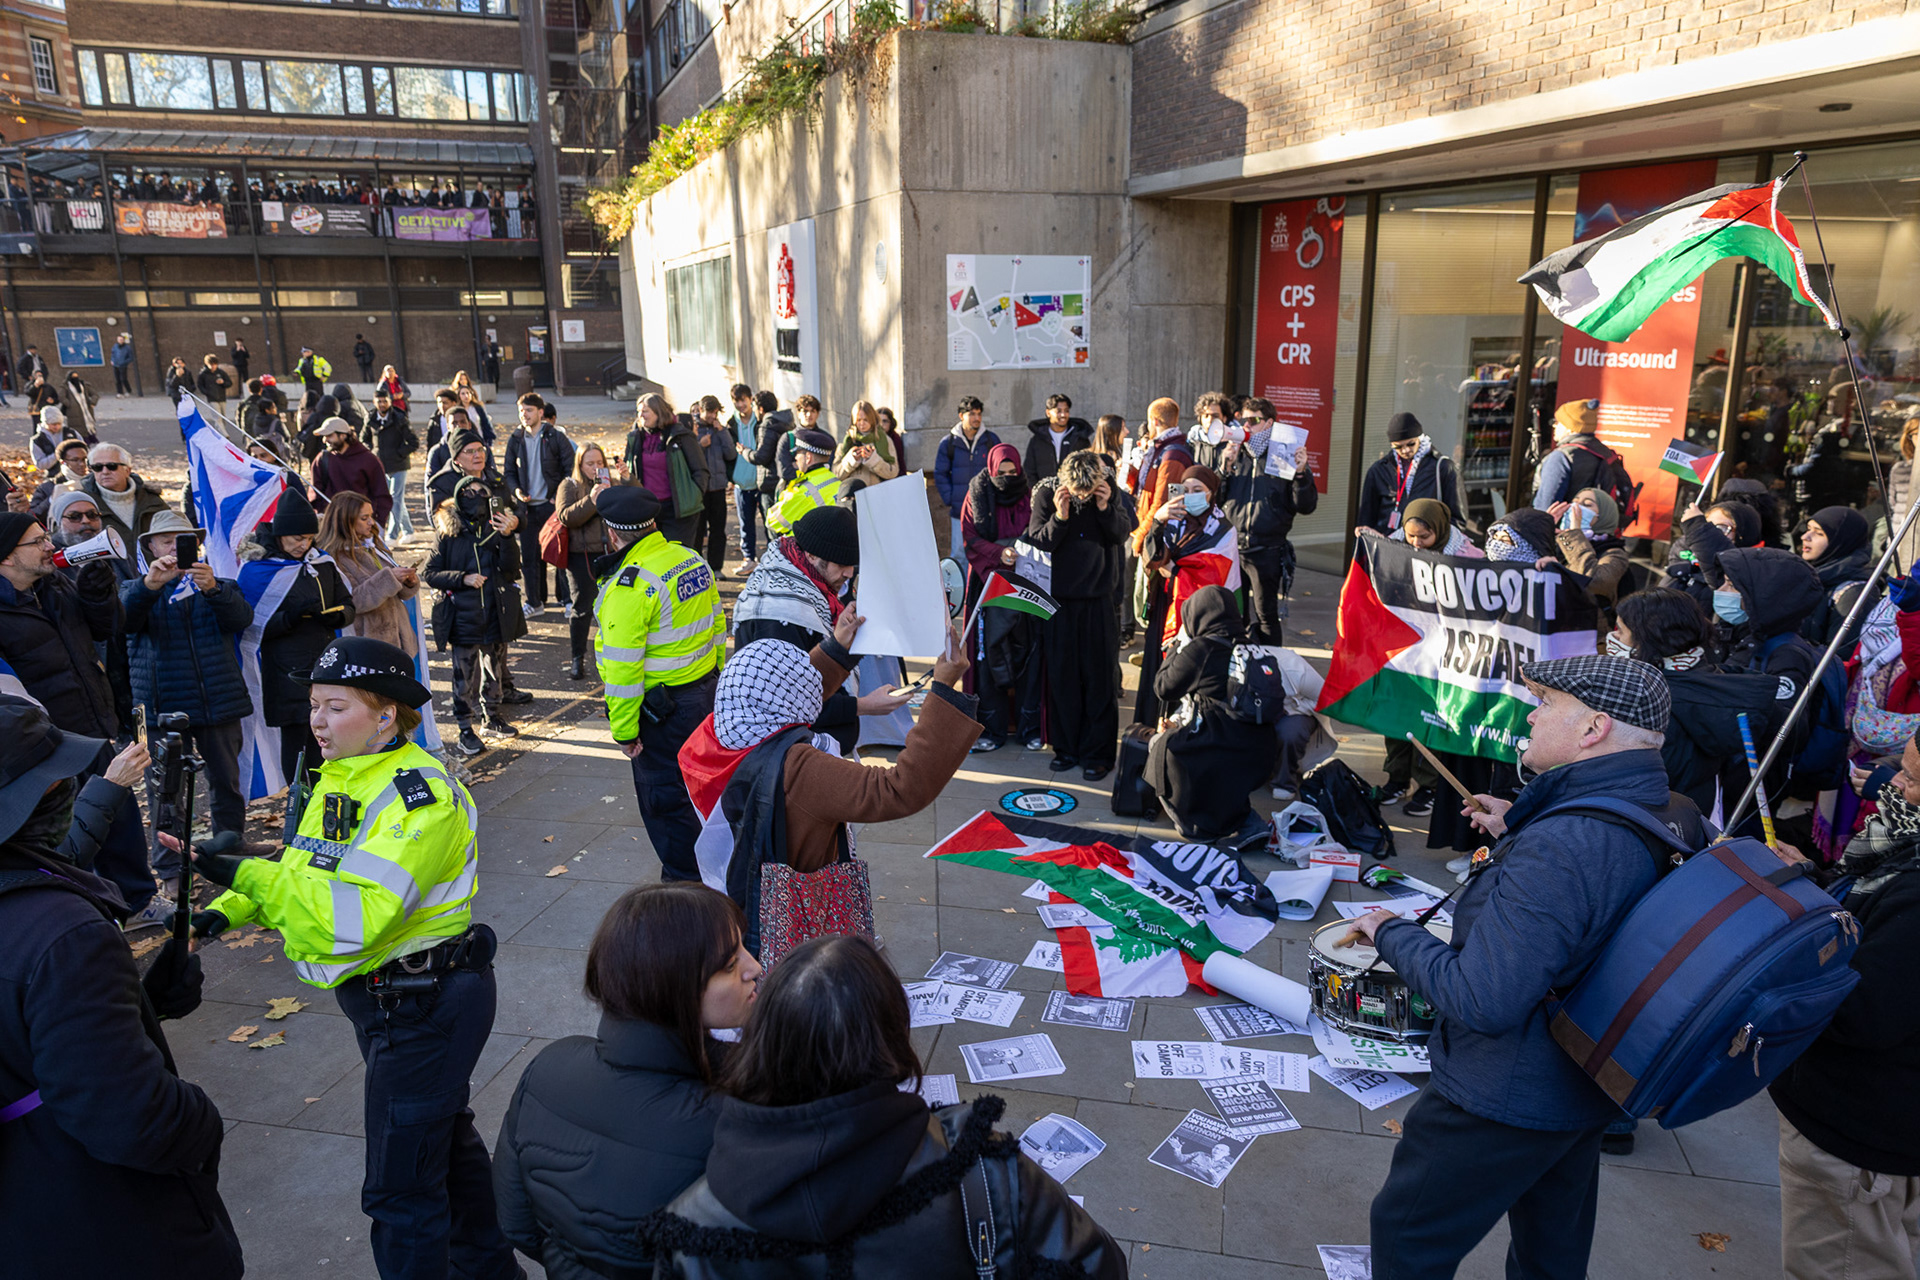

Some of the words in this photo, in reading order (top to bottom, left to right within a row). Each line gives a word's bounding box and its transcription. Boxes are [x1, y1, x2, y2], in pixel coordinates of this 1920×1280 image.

[170, 210, 221, 220] INVOLVED
[1270, 233, 1289, 244] CITY
[1280, 284, 1315, 307] CPS
[1277, 342, 1311, 365] CPR
[1573, 347, 1678, 370] Ultrasound
[1664, 449, 1680, 461] FOA
[1018, 588, 1040, 603] FOA
[1411, 558, 1562, 620] BOYCOTT
[950, 989, 976, 1017] CAMPUS
[1170, 1043, 1185, 1058] OFF
[1156, 1043, 1174, 1076] CAMPUS
[1239, 1051, 1252, 1076] CAMPU
[1253, 1060, 1265, 1074] OFF
[1211, 1081, 1266, 1099] SACK
[1351, 1072, 1388, 1093] CITY
[1218, 1092, 1273, 1107] MICHAEL
[1224, 1100, 1277, 1115] BEN-GAD
[1187, 1117, 1199, 1125] ON
[1199, 1122, 1220, 1132] YOUR
[1191, 1113, 1207, 1122] YOU
[1182, 1121, 1225, 1141] ANTHONY
